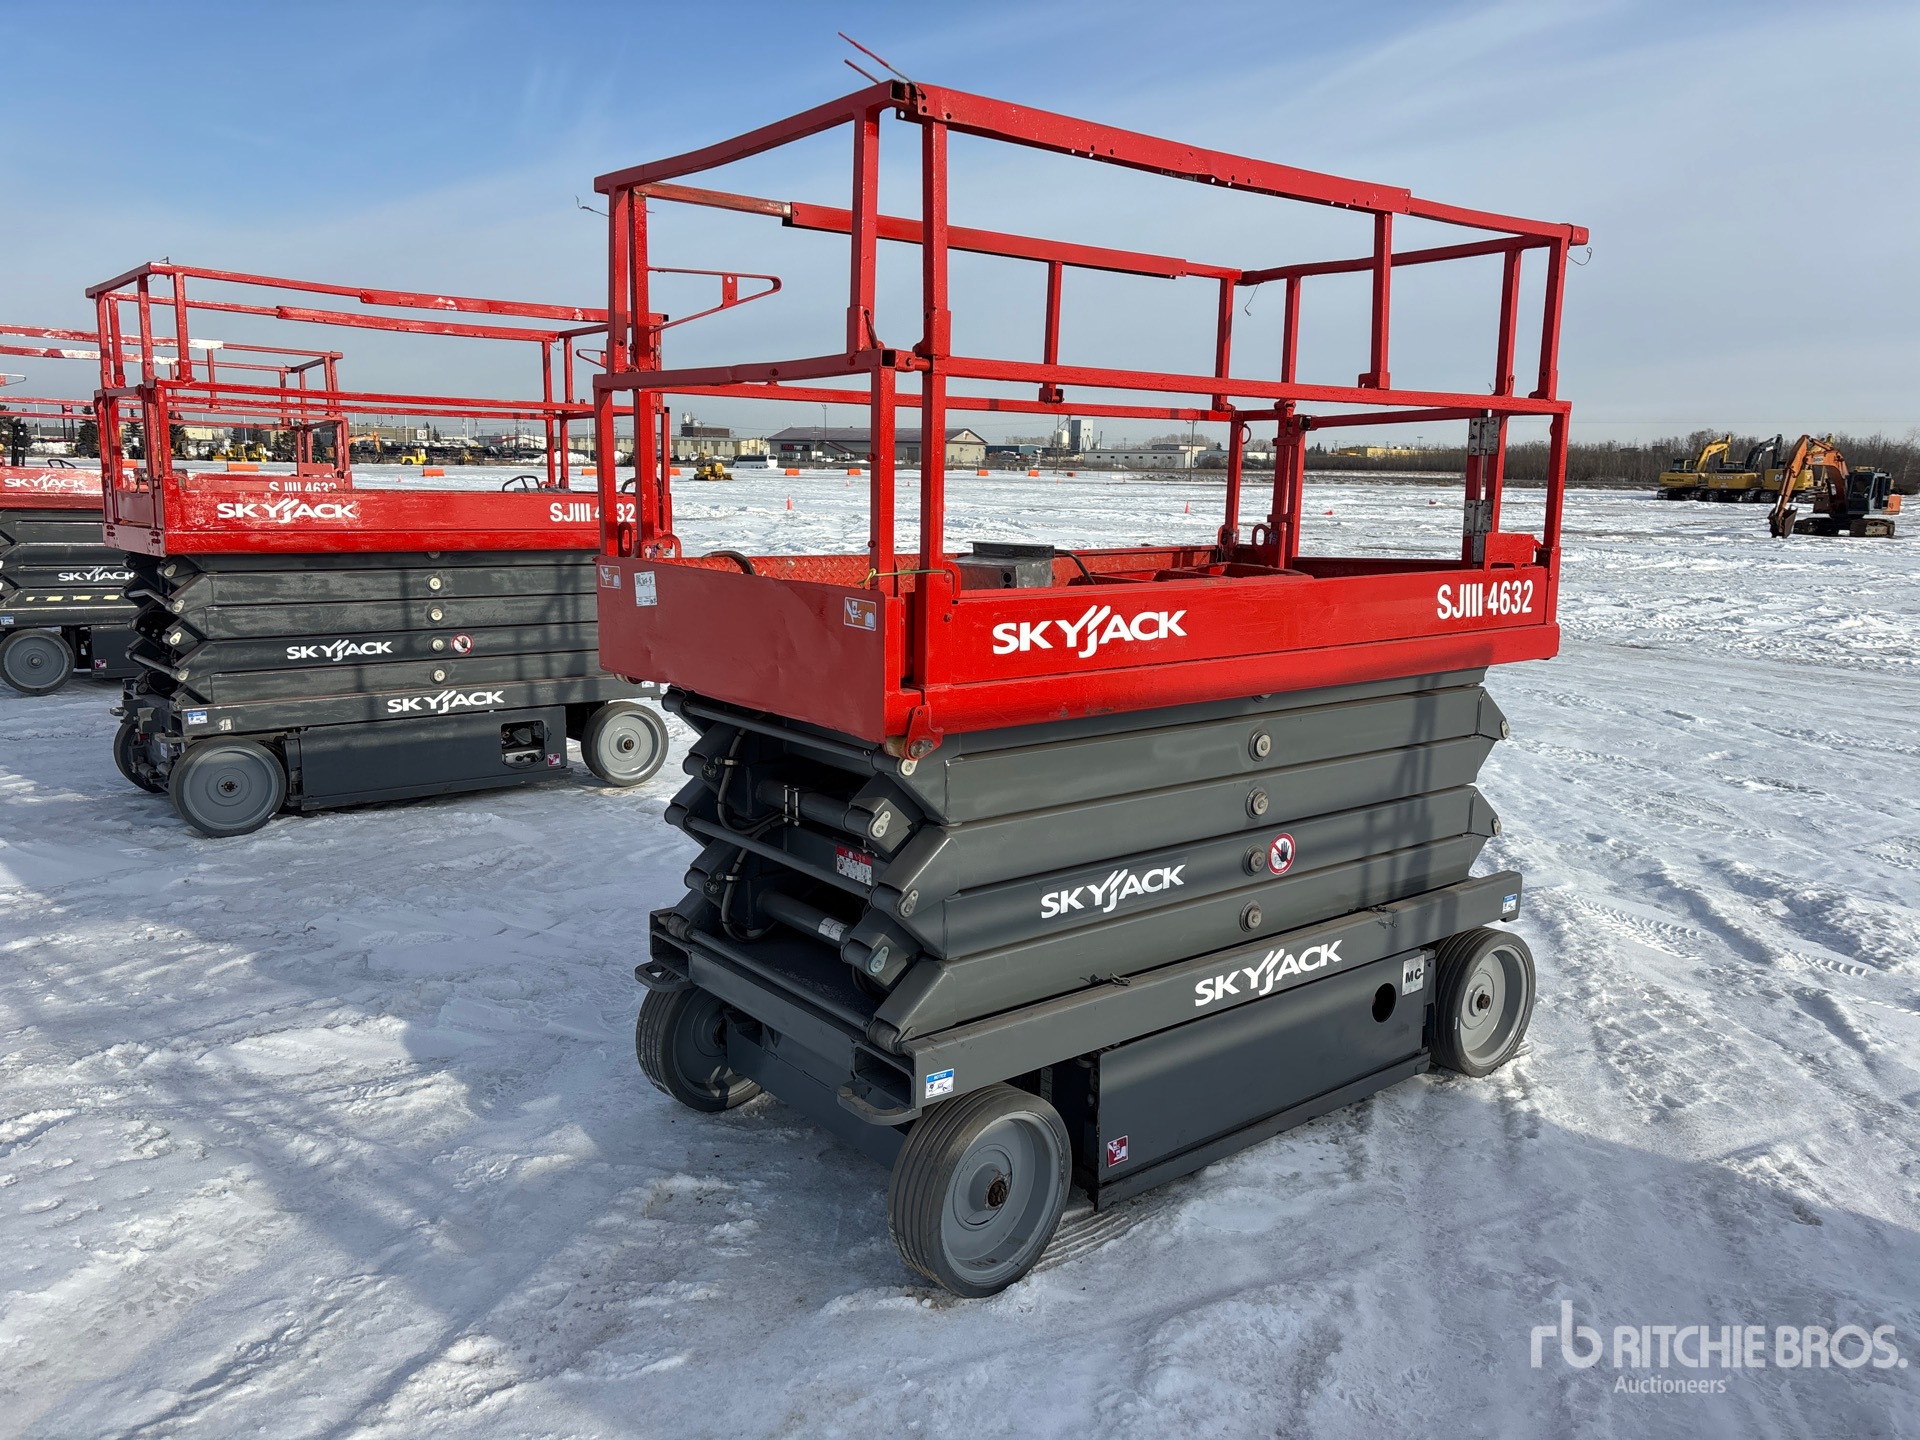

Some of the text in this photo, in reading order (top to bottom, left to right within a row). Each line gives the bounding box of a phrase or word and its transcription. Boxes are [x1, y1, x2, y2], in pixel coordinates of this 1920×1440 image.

[4, 473, 87, 490] SKYJACK
[216, 489, 357, 524] SKYJACK
[549, 502, 636, 522] SJIII 32
[1437, 579, 1534, 620] SJIII 4632
[992, 604, 1187, 658] SKYJACK
[286, 639, 393, 662] SKYJACK
[387, 689, 505, 715] SKYJACK
[1040, 864, 1185, 918] SKYJACK
[1194, 939, 1343, 1006] SKYJACK
